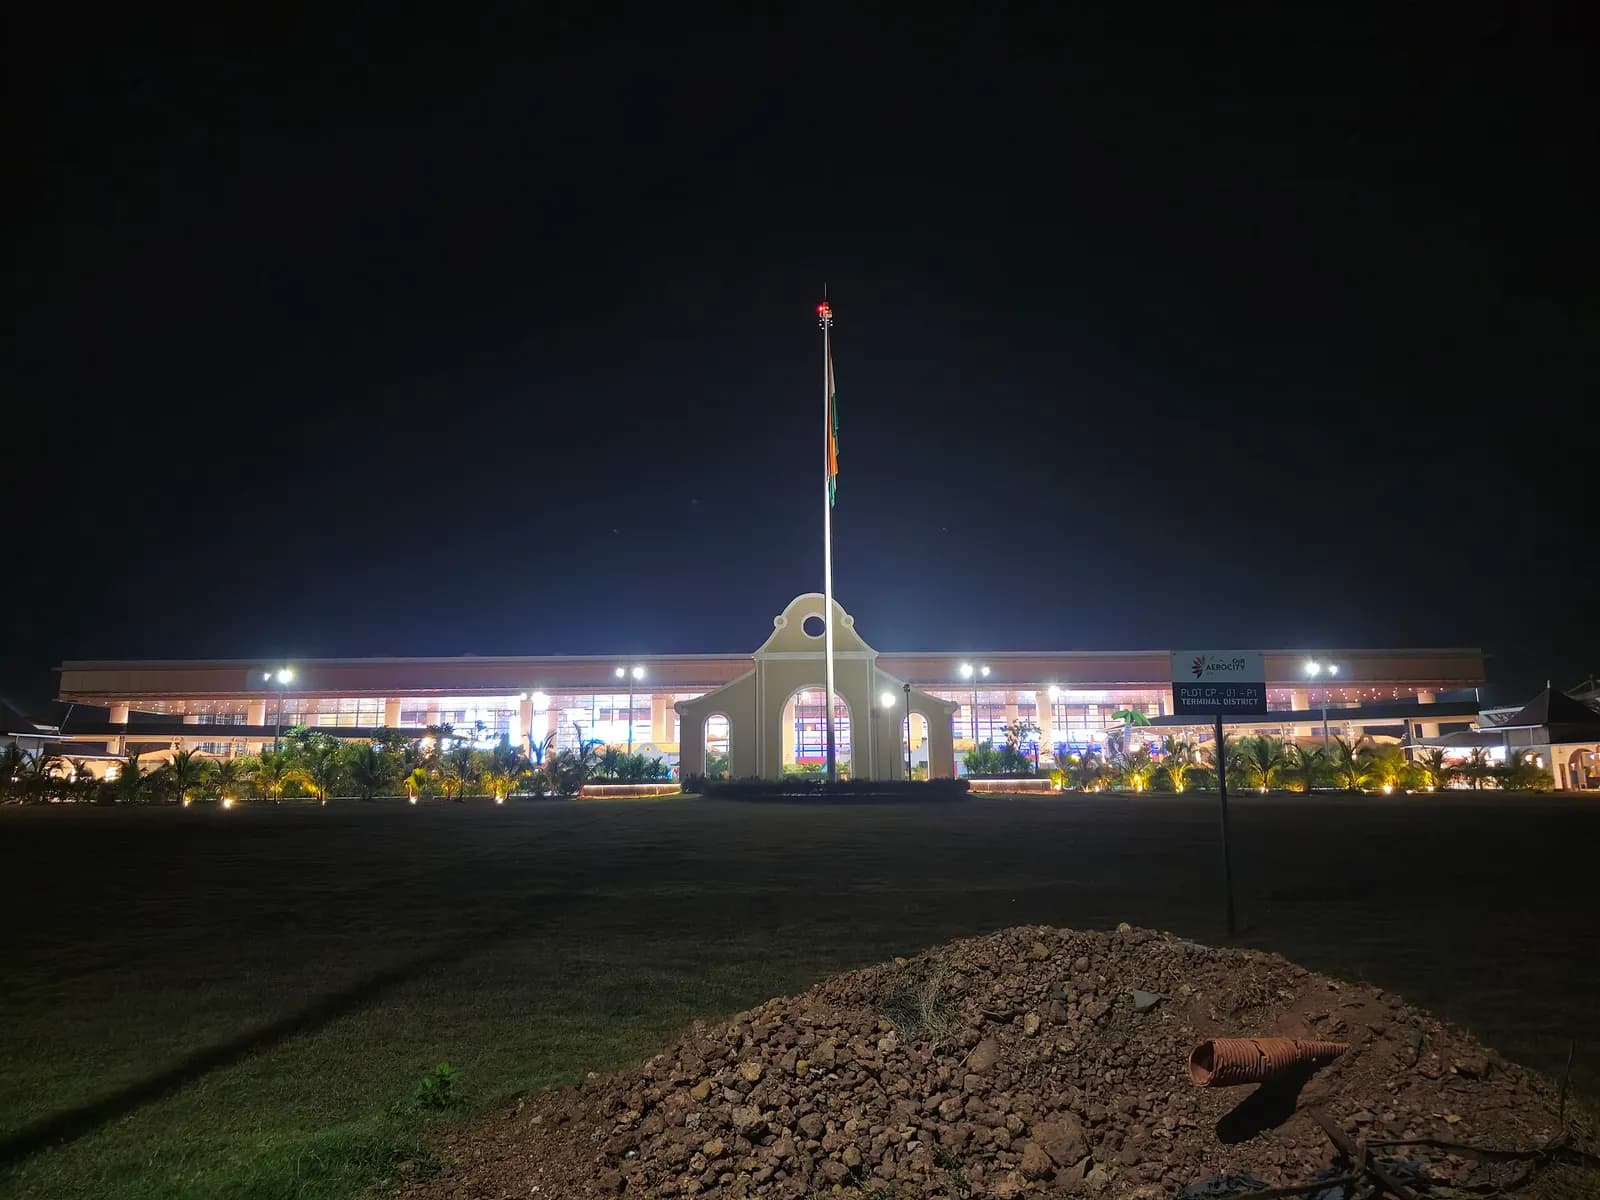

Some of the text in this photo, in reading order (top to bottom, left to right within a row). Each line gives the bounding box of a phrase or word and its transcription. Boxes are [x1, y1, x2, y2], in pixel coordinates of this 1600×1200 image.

[1206, 663, 1245, 671] AEROCITY
[1180, 688, 1202, 697] PLOT
[1205, 688, 1217, 697] CP
[1226, 688, 1236, 697] 01
[1246, 688, 1257, 697] P1
[1181, 698, 1259, 706] TERMINAL DISTRICT
